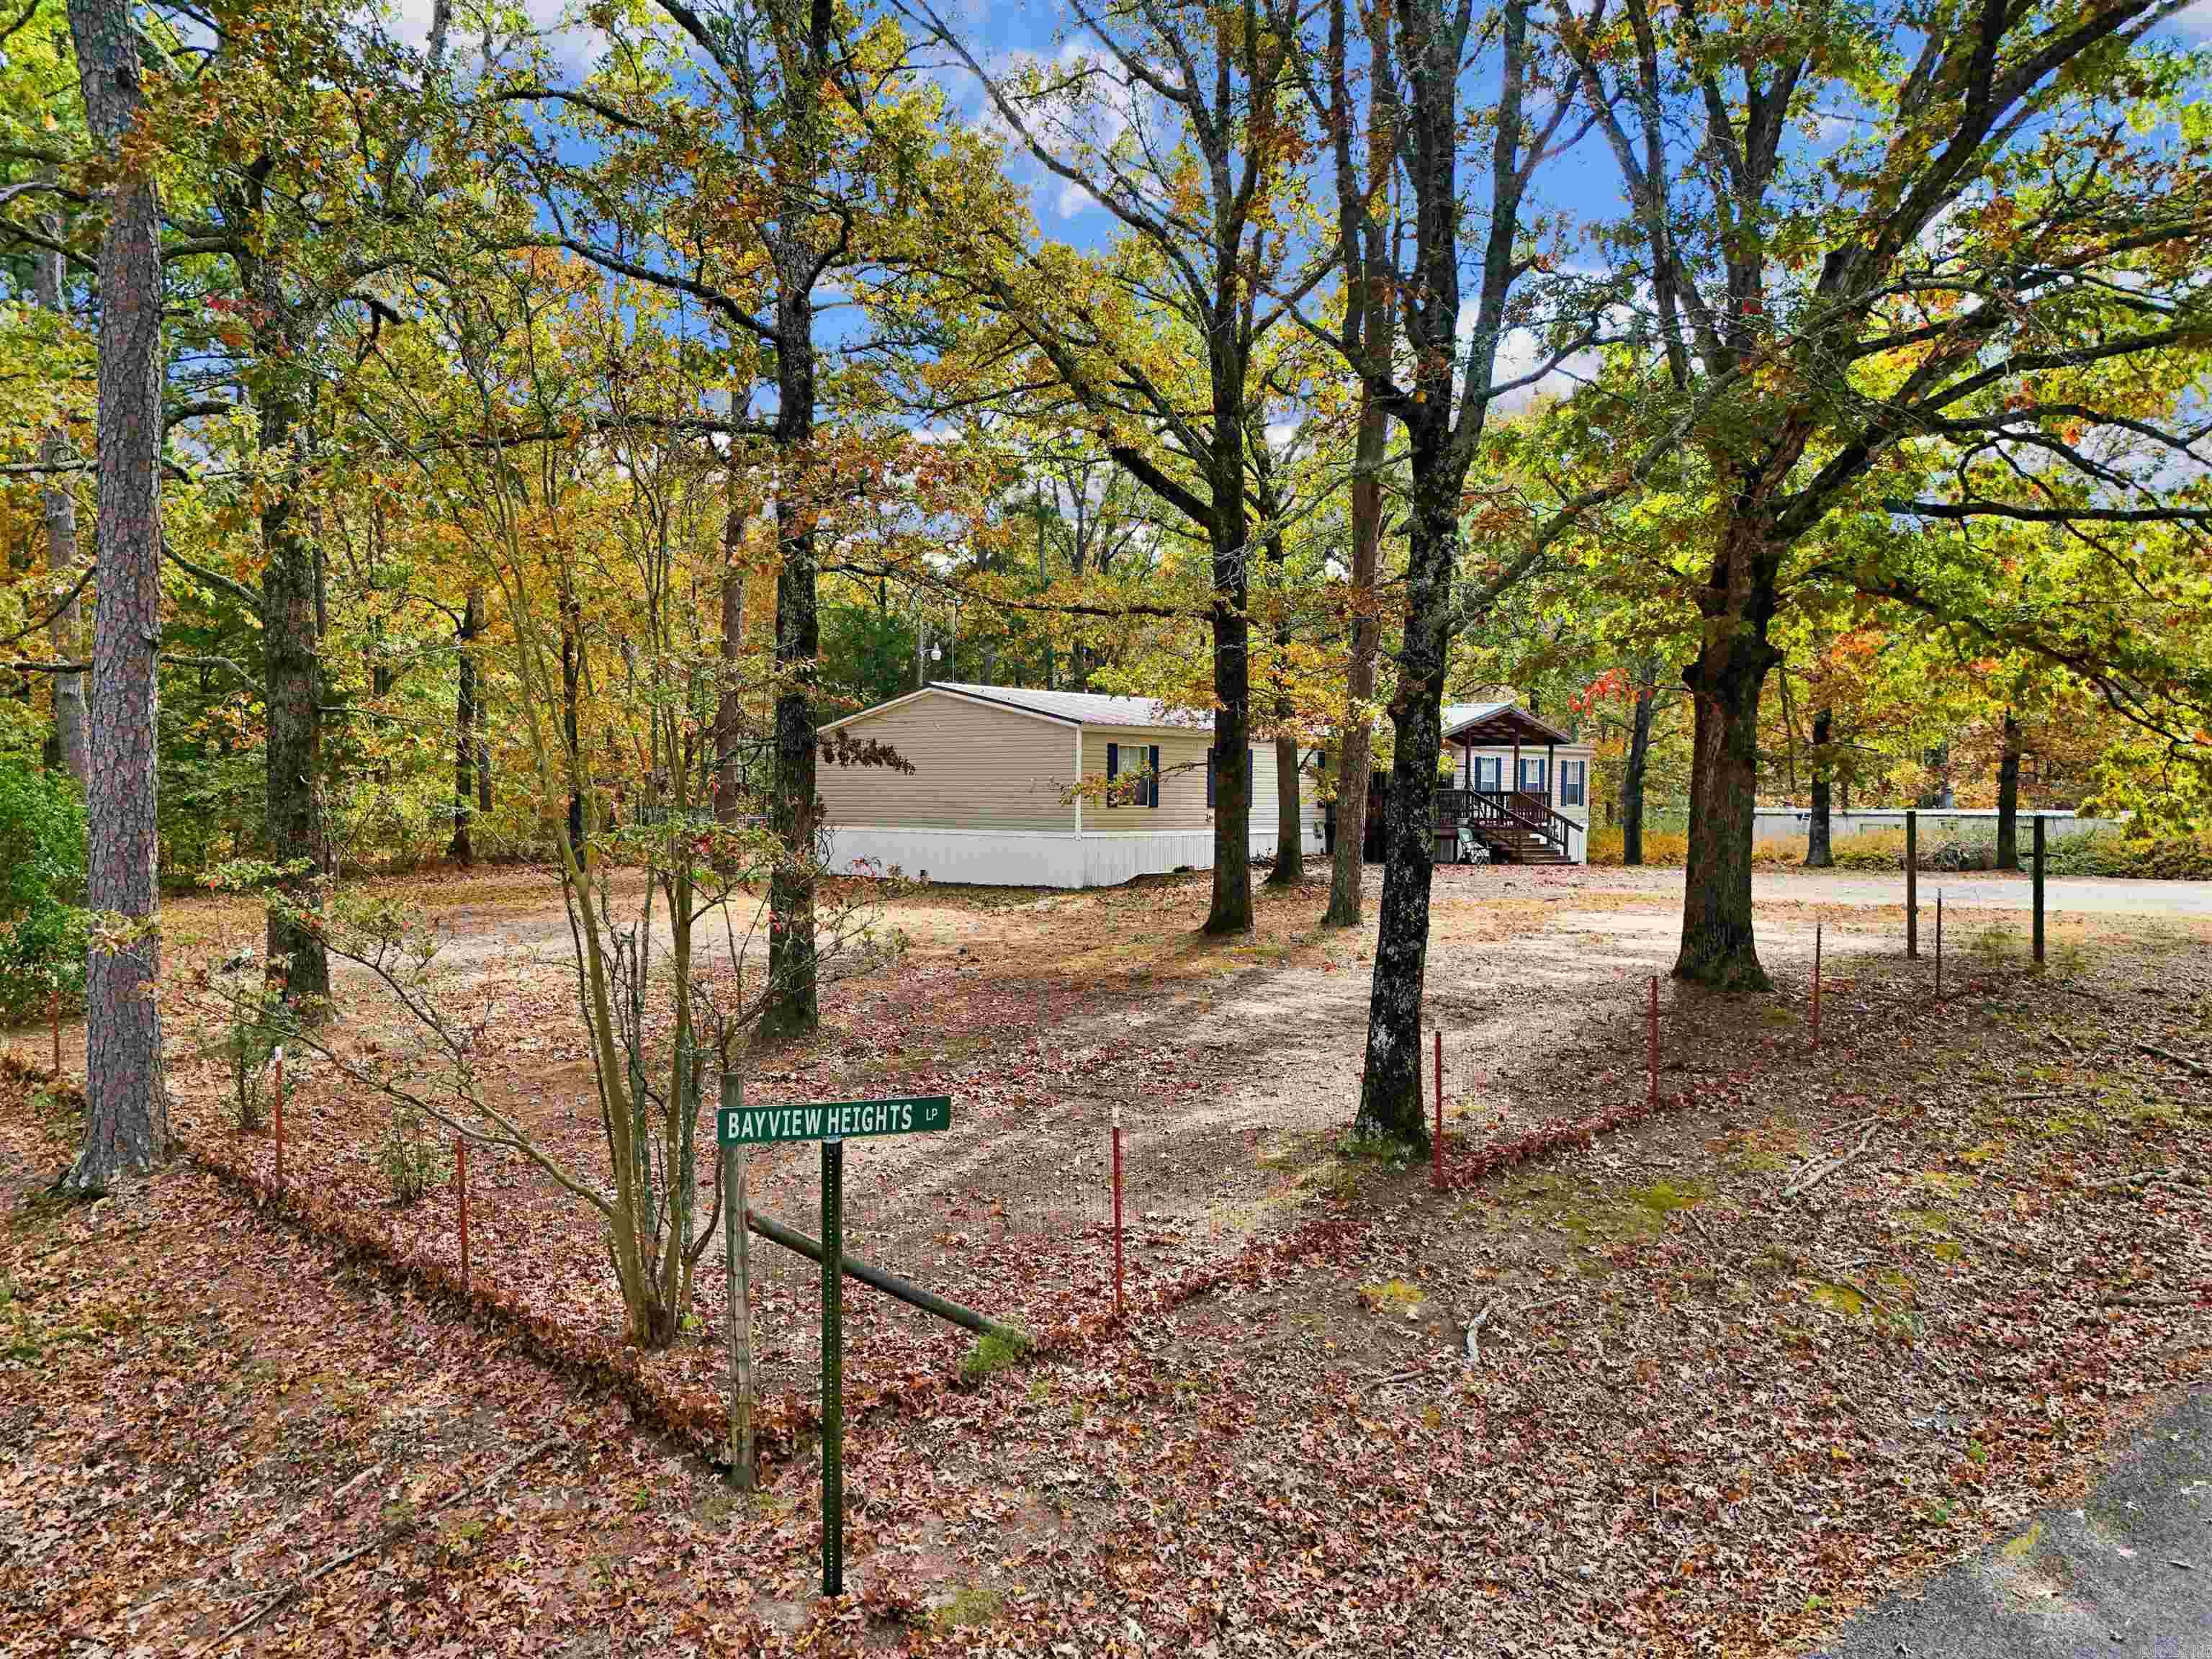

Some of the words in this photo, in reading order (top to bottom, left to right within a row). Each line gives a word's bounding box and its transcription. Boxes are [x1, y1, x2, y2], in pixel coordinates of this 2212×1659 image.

[728, 1109, 822, 1138] BAYVIEW
[828, 1105, 912, 1134] HEIGHTS
[926, 1107, 938, 1120] LP
